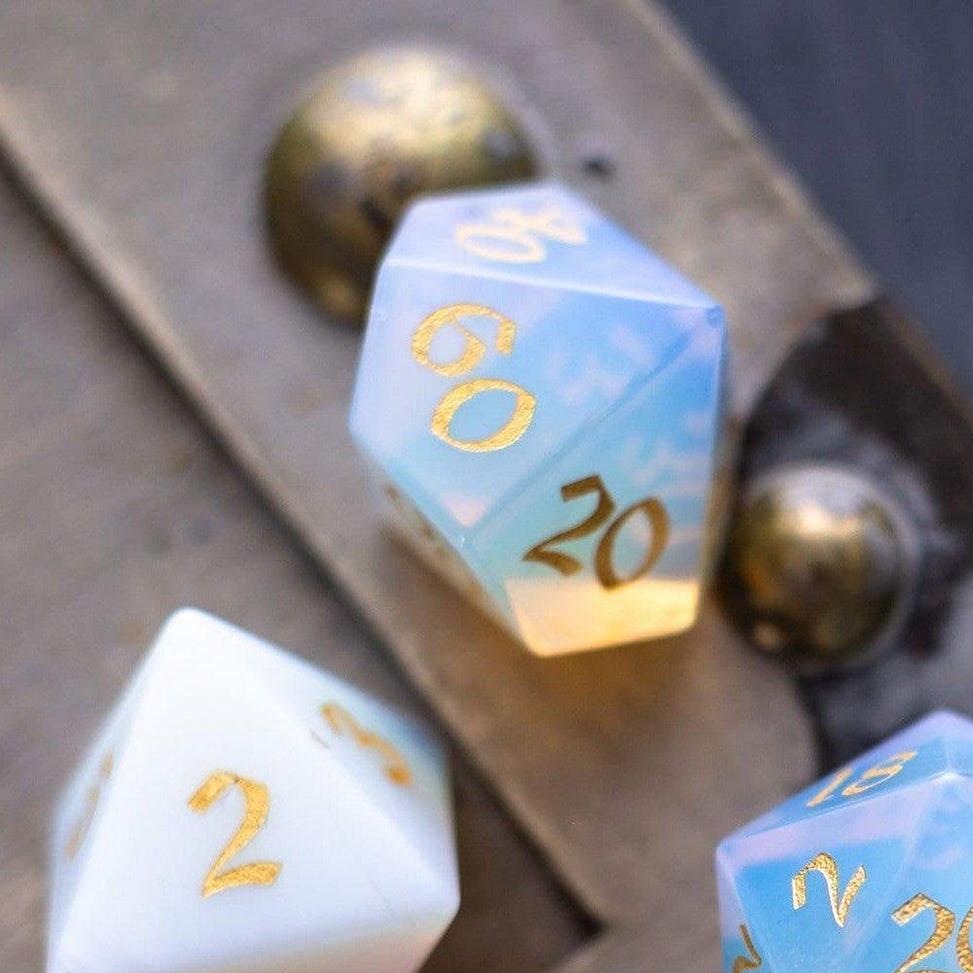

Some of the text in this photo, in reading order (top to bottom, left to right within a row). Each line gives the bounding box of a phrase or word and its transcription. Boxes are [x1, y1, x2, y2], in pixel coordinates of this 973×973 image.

[411, 303, 537, 453] 60
[522, 475, 670, 593] 20
[188, 770, 282, 899] 2
[791, 852, 867, 928] 2
